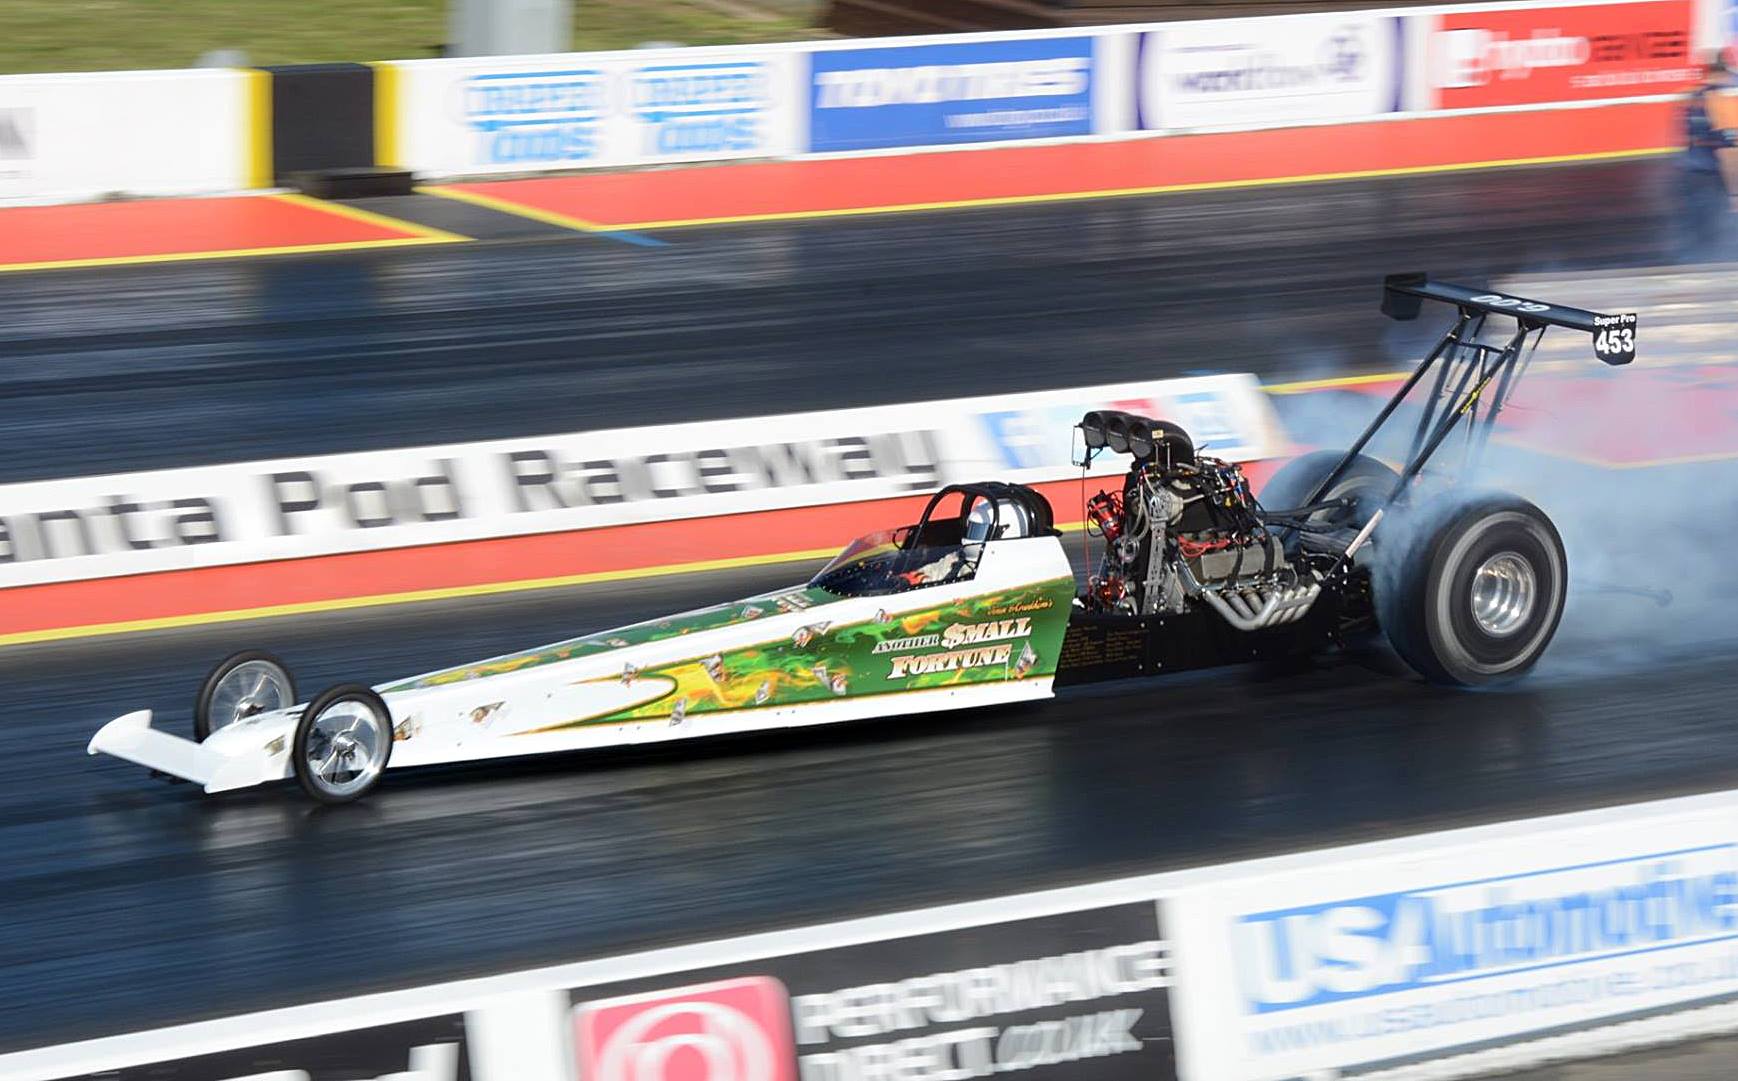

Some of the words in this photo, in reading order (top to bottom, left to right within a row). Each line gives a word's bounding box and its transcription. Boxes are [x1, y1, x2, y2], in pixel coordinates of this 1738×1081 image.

[1593, 316, 1620, 327] Super
[1620, 314, 1636, 323] Pro
[1595, 328, 1634, 354] 453
[266, 458, 464, 536] Pod
[506, 430, 942, 513] Raceway
[887, 643, 1012, 679] FORTUNE
